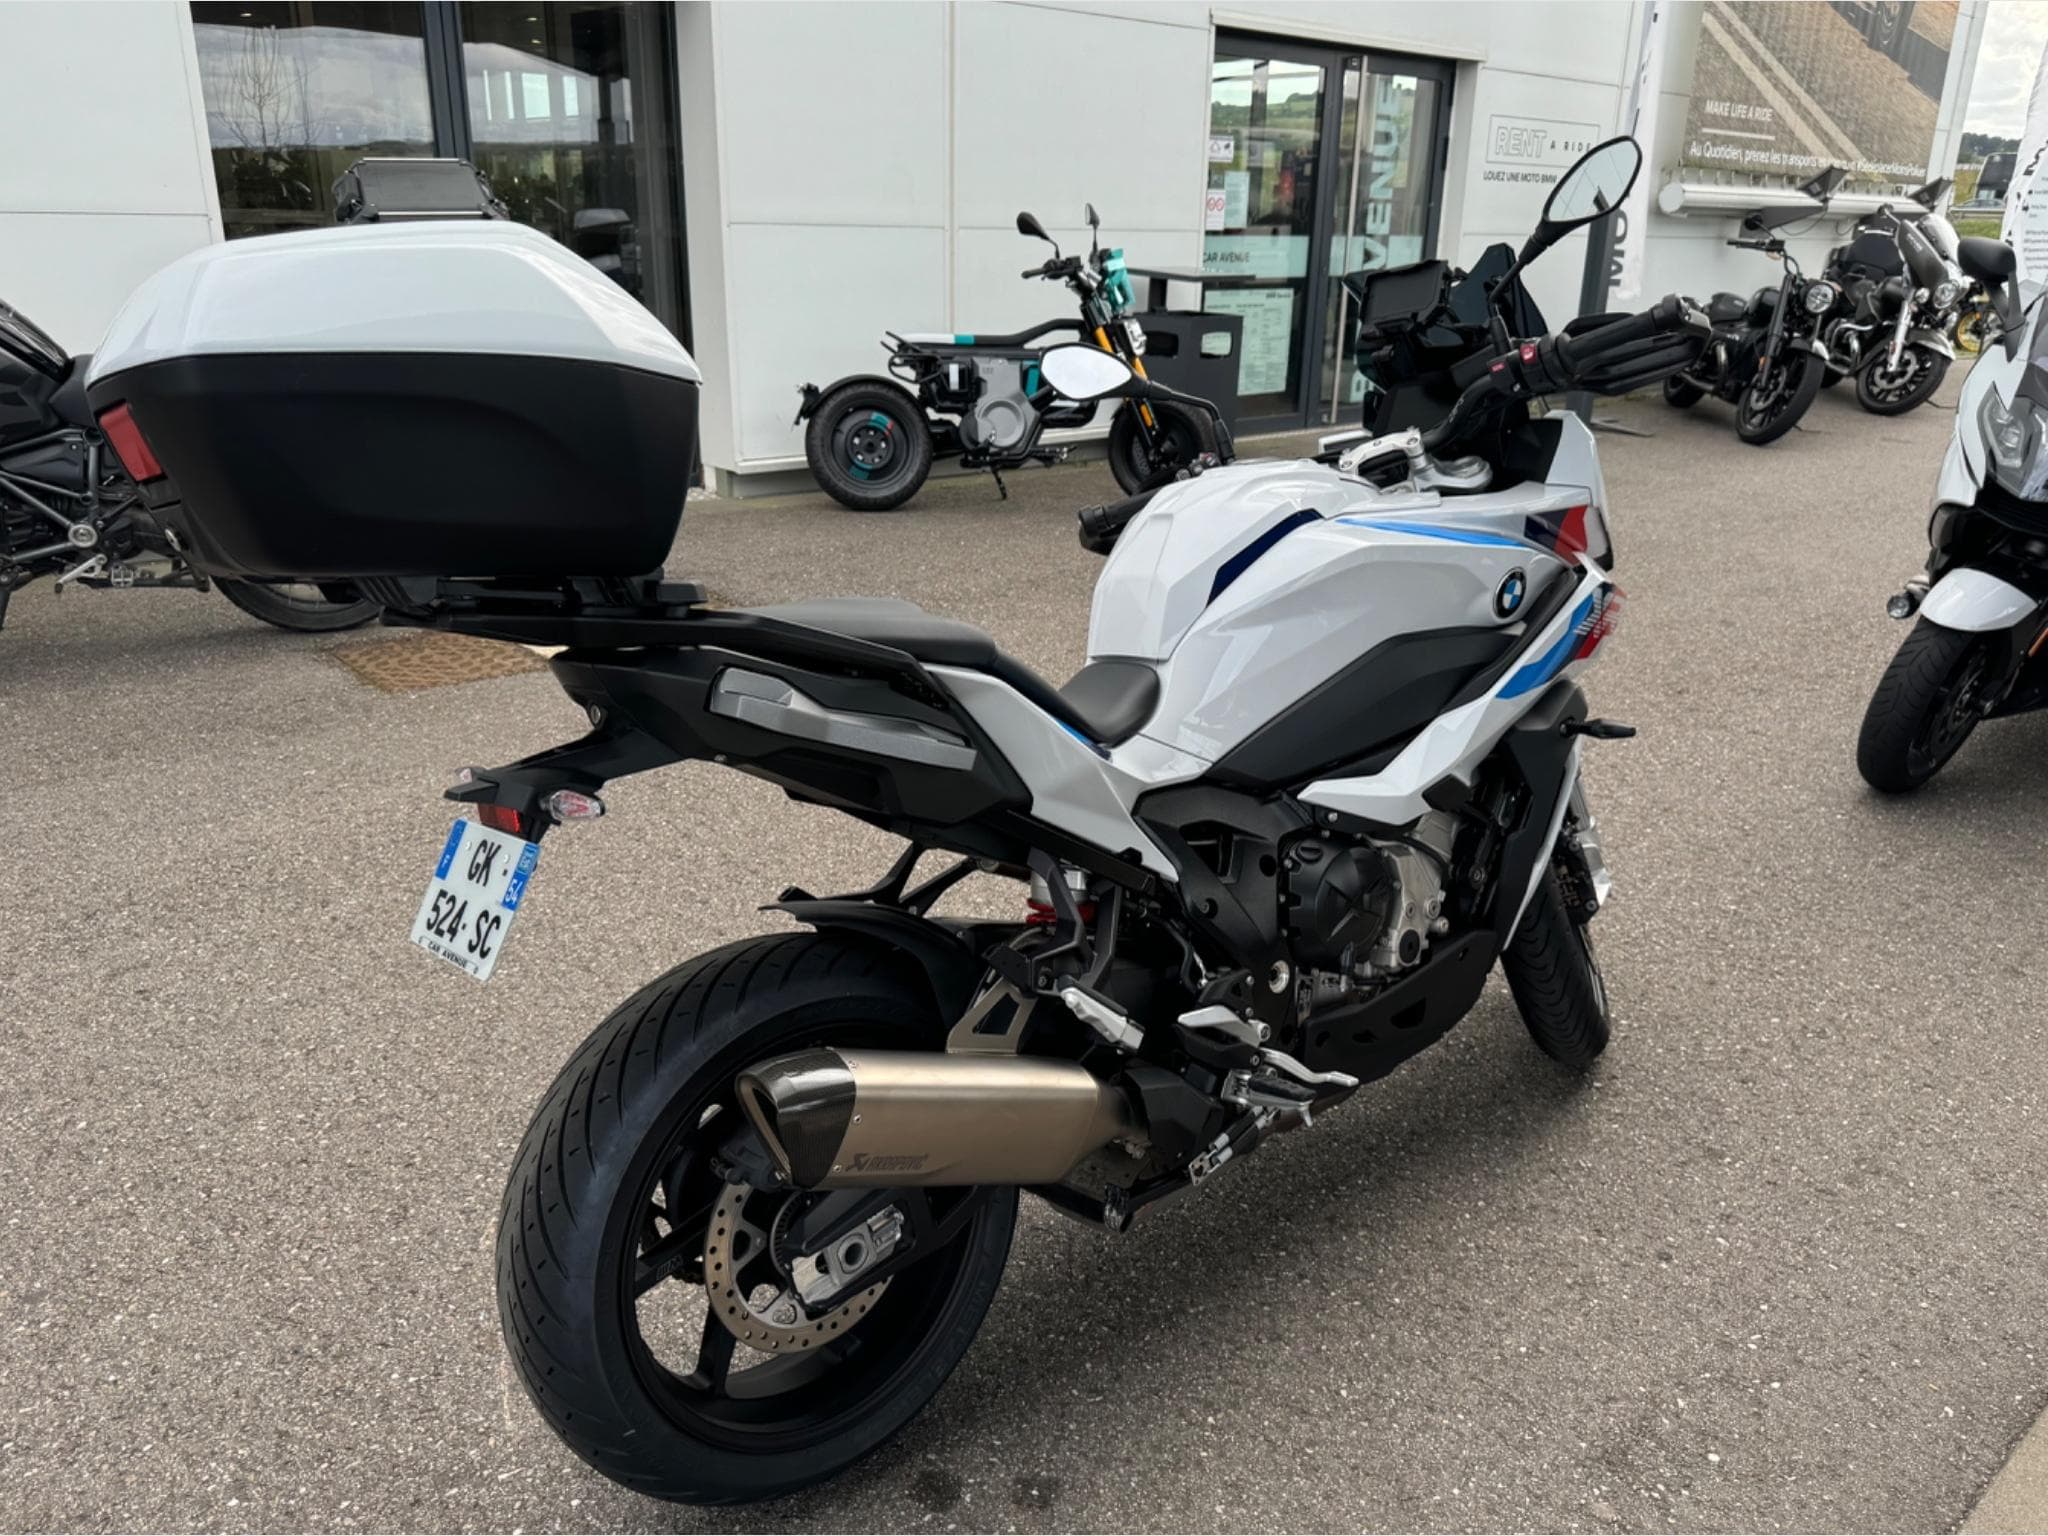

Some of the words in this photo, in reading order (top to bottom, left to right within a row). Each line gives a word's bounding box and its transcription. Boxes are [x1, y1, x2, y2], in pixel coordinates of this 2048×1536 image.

[1704, 100, 1730, 116] MAKE
[1731, 103, 1748, 119] LIFE
[1748, 106, 1754, 119] A
[1755, 107, 1774, 121] RIDE
[1495, 126, 1547, 159] RENT
[1550, 141, 1556, 150] A
[1690, 140, 1702, 156] Au
[1744, 149, 1769, 164] prenez
[1770, 148, 1781, 164] les
[1483, 170, 1505, 181] LOUEZ
[1506, 171, 1520, 182] UNE
[1520, 172, 1540, 183] MOTO
[1541, 173, 1557, 184] BMW
[1203, 252, 1219, 263] CAR
[1219, 252, 1249, 263] AVENUE
[505, 879, 523, 905] 54
[442, 948, 468, 969] AVENUE
